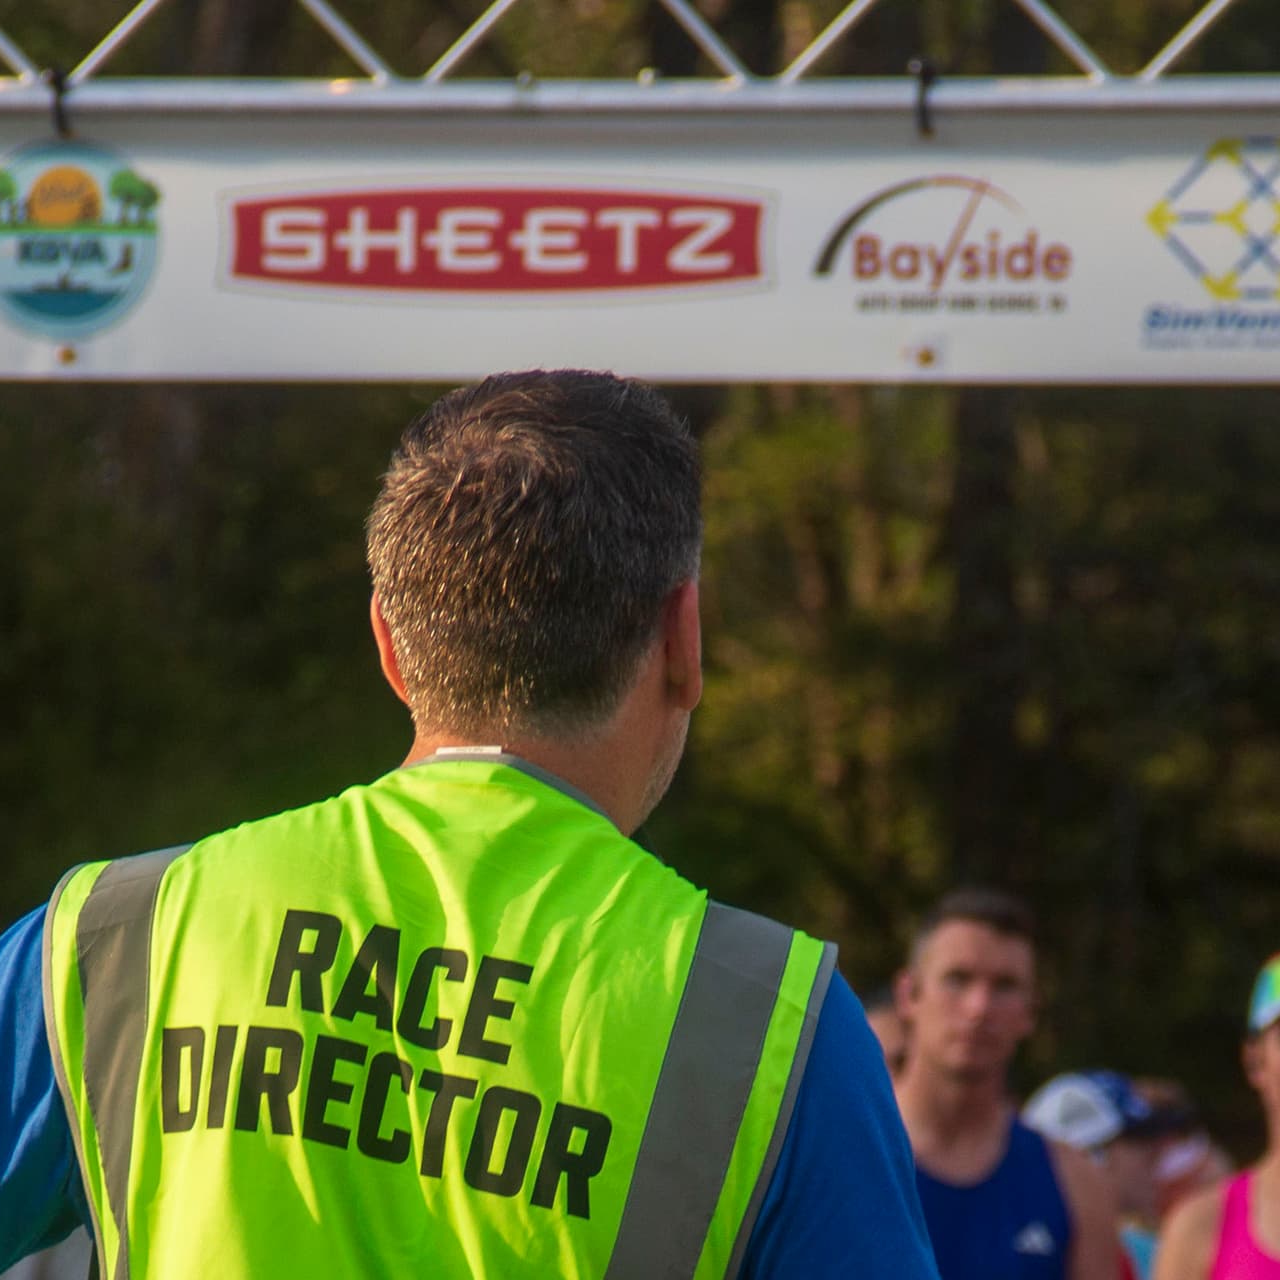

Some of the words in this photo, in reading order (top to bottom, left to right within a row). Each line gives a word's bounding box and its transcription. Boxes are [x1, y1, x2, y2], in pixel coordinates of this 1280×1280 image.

[260, 206, 733, 273] SHEETZ
[852, 227, 1073, 292] Bayside
[265, 909, 534, 1066] RACE
[161, 1024, 613, 1221] DIRECTOR
